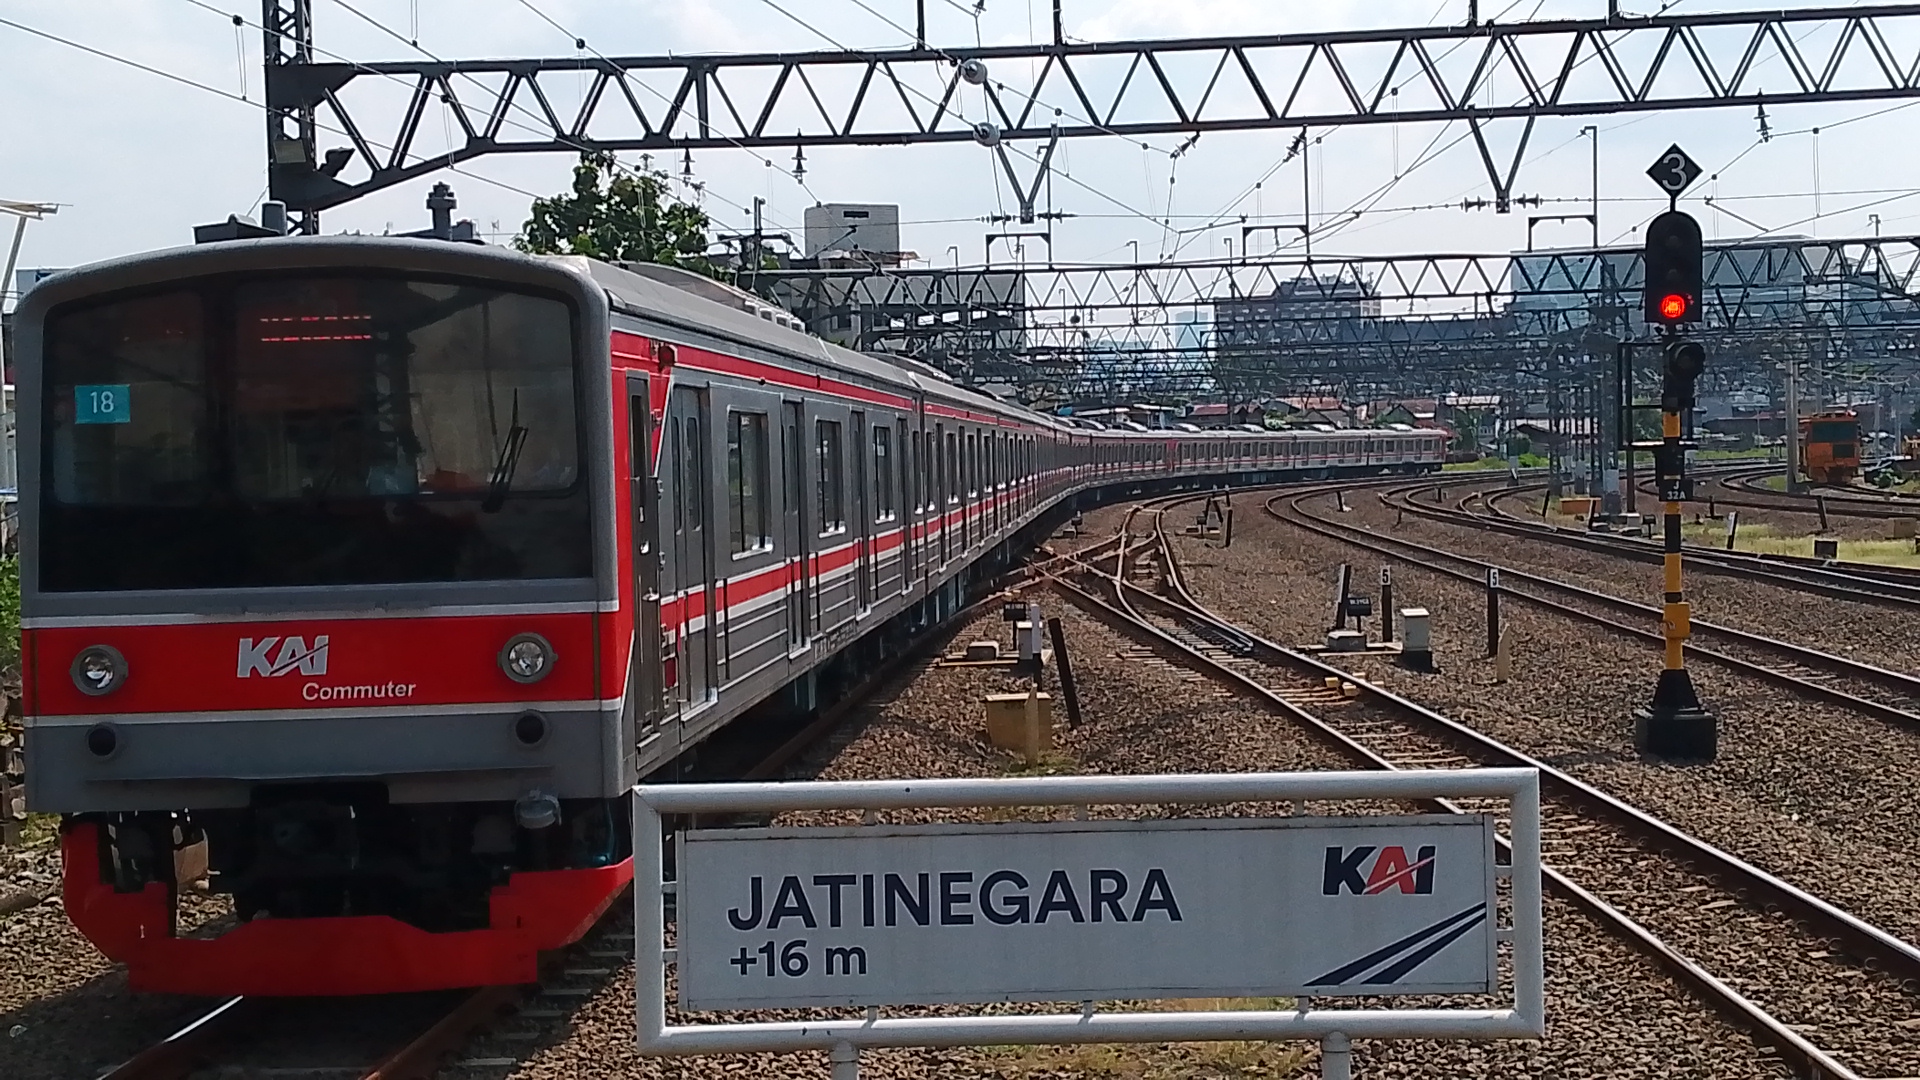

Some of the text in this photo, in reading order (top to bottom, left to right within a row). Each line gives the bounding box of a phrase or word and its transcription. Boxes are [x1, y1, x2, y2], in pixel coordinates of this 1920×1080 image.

[1662, 153, 1687, 190] 3
[90, 391, 114, 413] 18
[1667, 491, 1686, 500] 32A
[1673, 480, 1680, 490] J
[1382, 569, 1389, 583] 5
[1492, 571, 1498, 586] 5
[237, 635, 329, 678] KAI
[302, 681, 416, 700] Commuter
[1322, 845, 1436, 895] KAI
[727, 868, 1183, 931] JATINEGARA
[730, 940, 867, 977] +16 m
